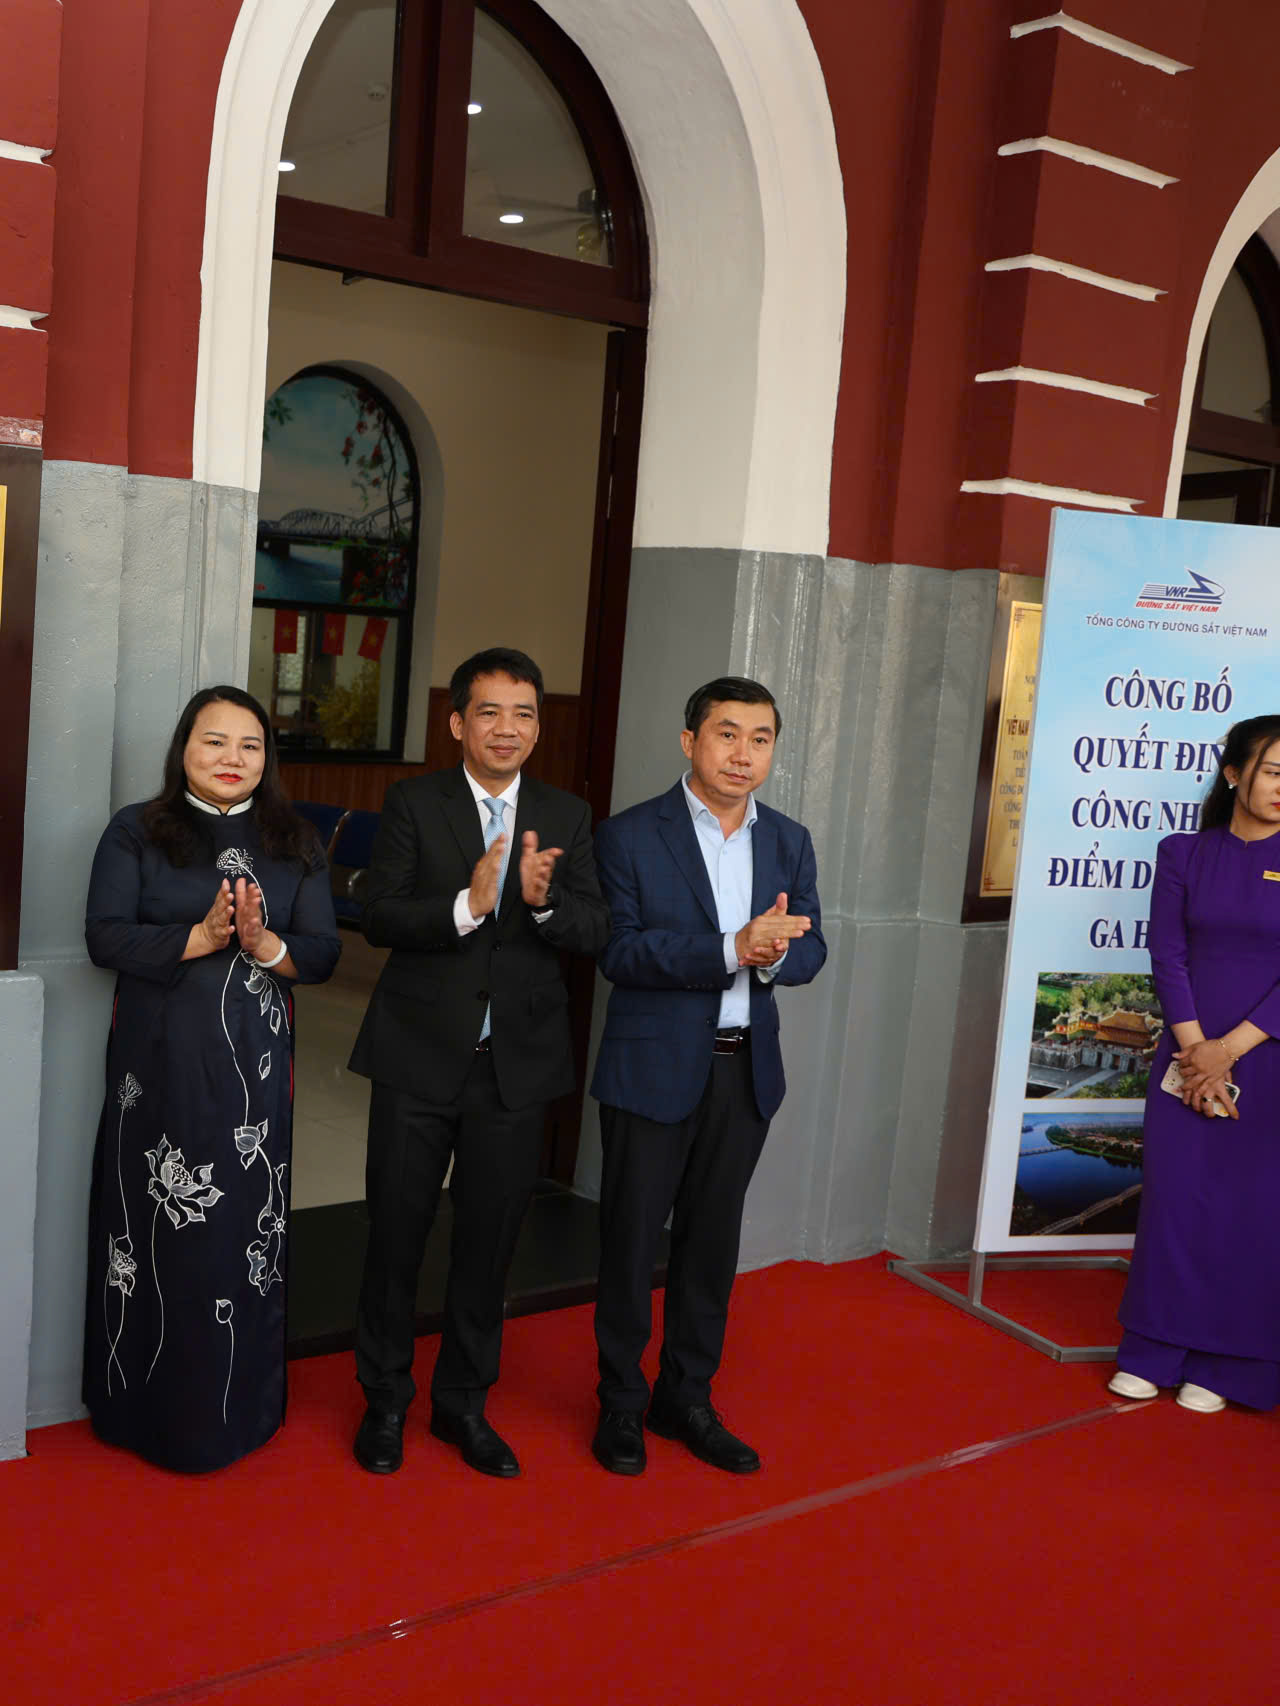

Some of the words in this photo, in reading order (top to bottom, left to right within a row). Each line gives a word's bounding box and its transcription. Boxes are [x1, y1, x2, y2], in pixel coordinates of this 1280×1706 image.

[1164, 585, 1188, 598] VNR
[1200, 605, 1219, 613] NAM
[1116, 616, 1145, 629] CÔNG
[1148, 620, 1160, 630] TY
[1223, 625, 1244, 638] VIỆT
[1245, 628, 1268, 637] NAM
[1105, 669, 1185, 711] CÔNG
[1192, 665, 1232, 713] BỐ
[1073, 722, 1168, 773] QUYẾT
[1174, 741, 1226, 783] ĐỊN
[1072, 789, 1151, 830] CÔNG
[1158, 801, 1201, 832] NH
[1047, 841, 1125, 889] ĐIỂM
[1131, 860, 1155, 889] D
[1089, 918, 1125, 948] GA
